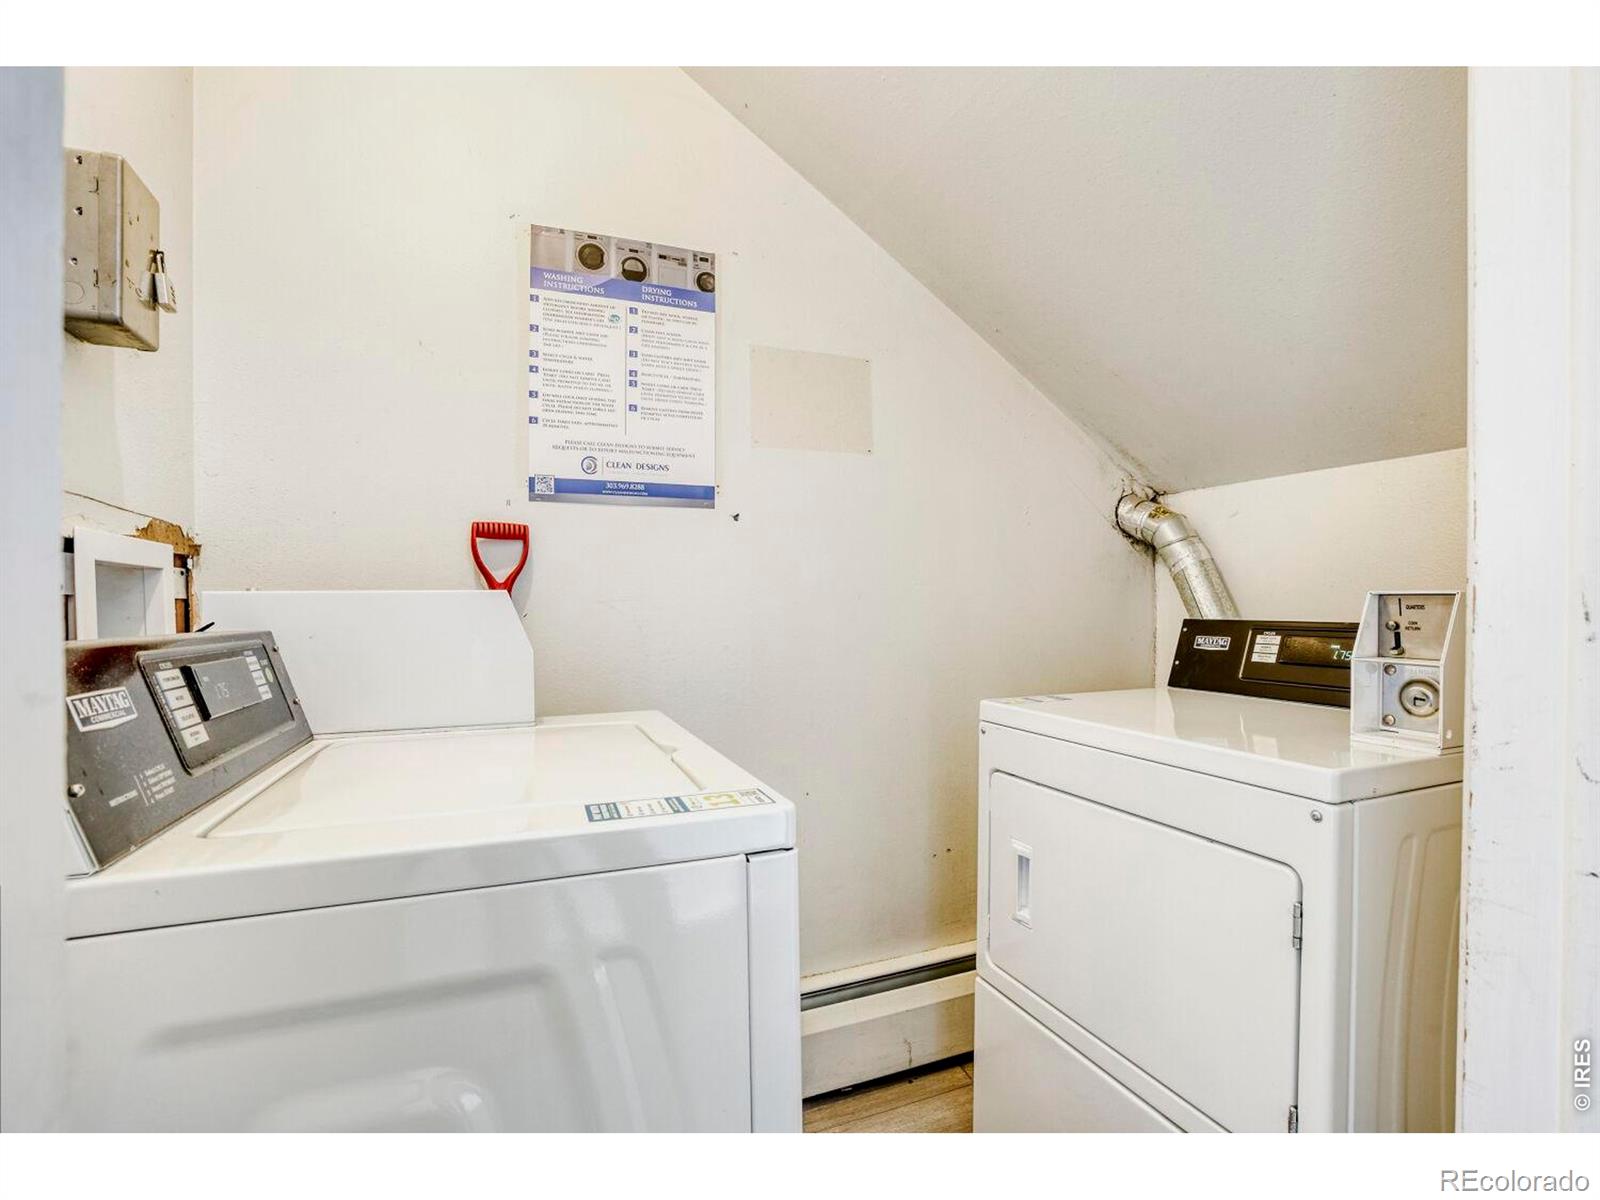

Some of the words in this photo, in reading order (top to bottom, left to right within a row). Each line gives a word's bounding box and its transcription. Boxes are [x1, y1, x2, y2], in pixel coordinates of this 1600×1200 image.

[543, 272, 584, 285] WASHING
[543, 280, 605, 295] INSTRUCTIONS
[642, 285, 672, 297] DRYING
[642, 294, 698, 308] INSTRUCTIONS
[606, 461, 632, 469] CLEAN
[636, 463, 670, 471] DESIGNS
[1197, 637, 1229, 646] MAYTAG
[72, 691, 131, 719] MAYTAG
